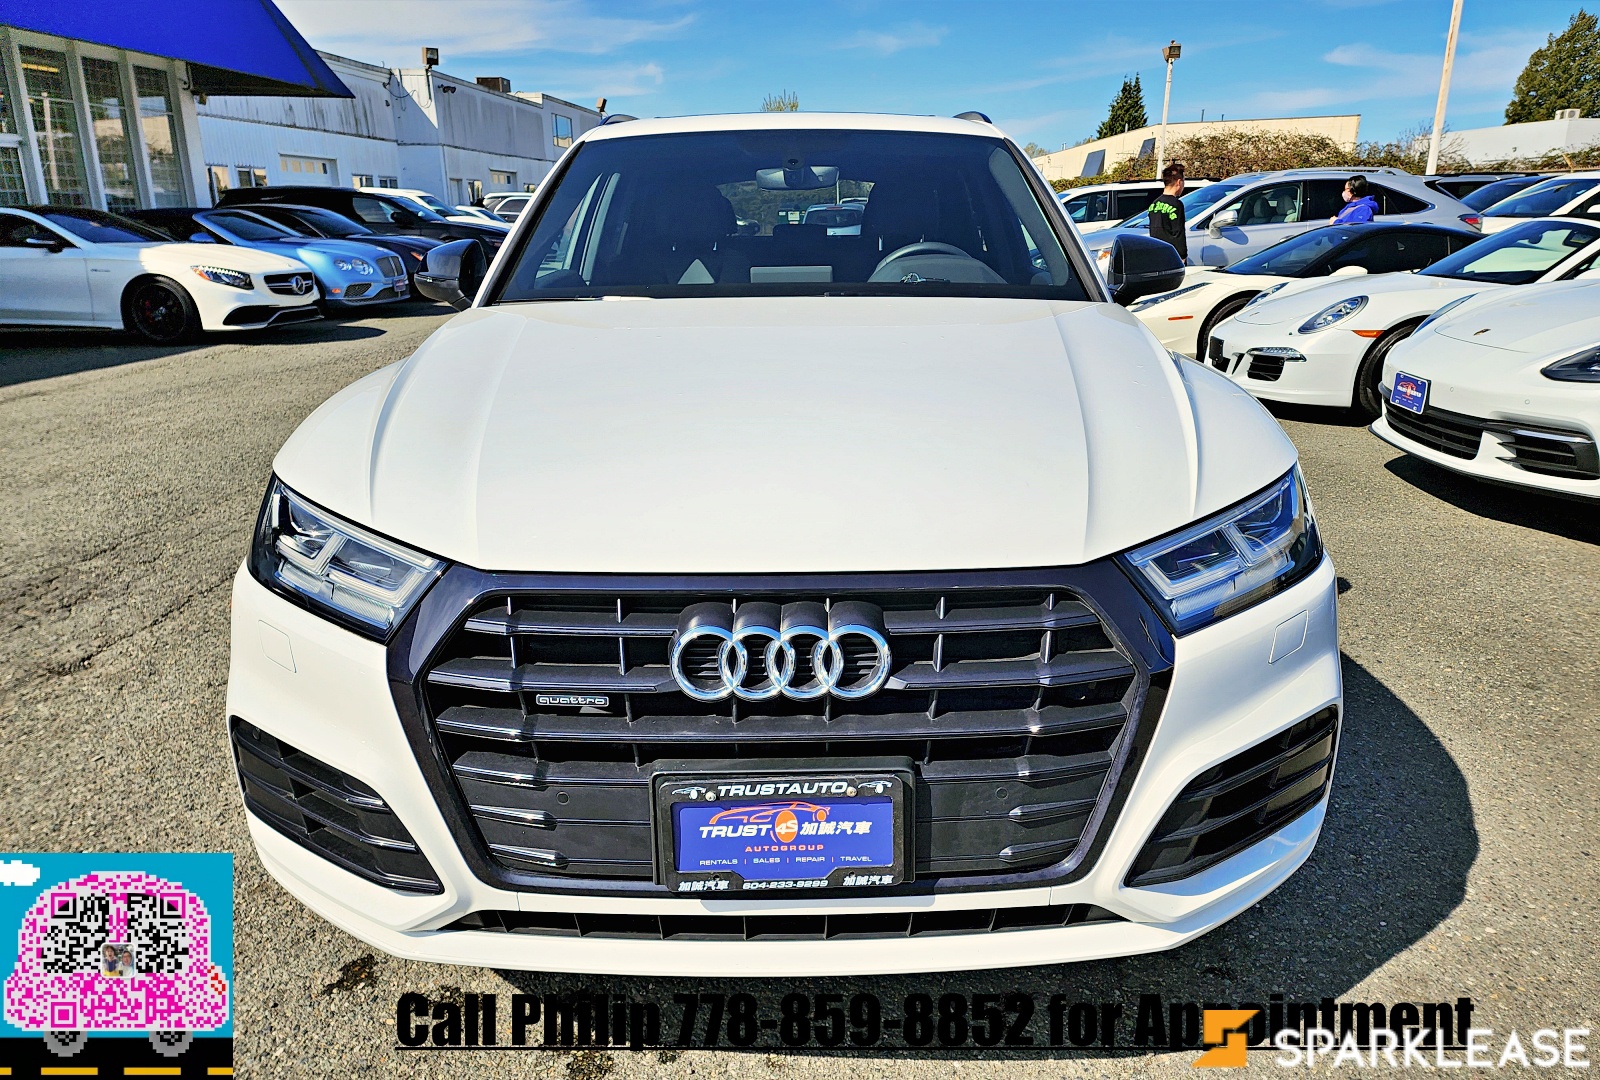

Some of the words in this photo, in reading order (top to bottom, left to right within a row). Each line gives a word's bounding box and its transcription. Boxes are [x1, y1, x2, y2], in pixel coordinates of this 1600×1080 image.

[539, 696, 605, 705] quattro
[717, 781, 848, 797] TRUSTAUTO
[699, 824, 773, 839] TRUST
[799, 821, 873, 835] 加誠汽車
[745, 844, 824, 852] AUTOGROUP
